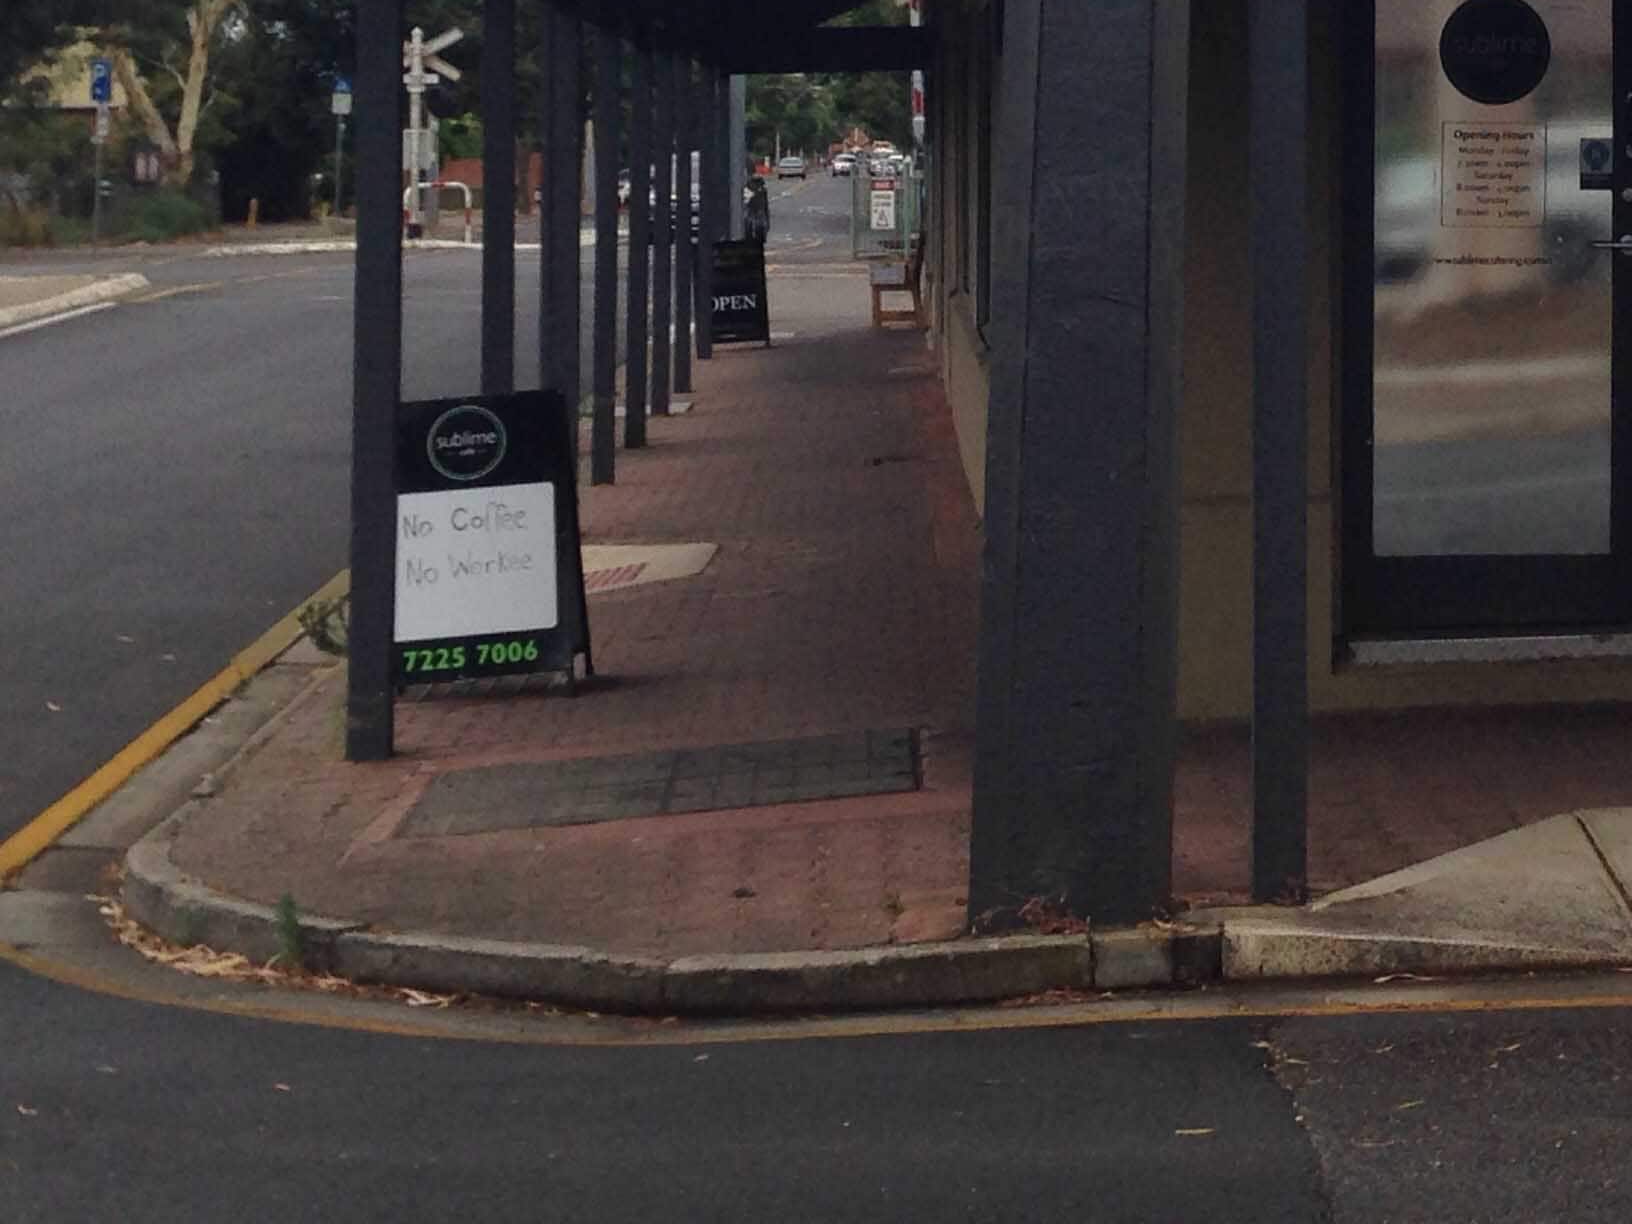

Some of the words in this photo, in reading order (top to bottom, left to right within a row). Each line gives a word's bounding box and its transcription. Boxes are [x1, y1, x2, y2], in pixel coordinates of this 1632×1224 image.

[1453, 129, 1500, 143] Opening
[402, 514, 433, 539] No
[450, 502, 528, 533] Coffee
[405, 558, 439, 588] No
[403, 646, 465, 672] 7225
[476, 640, 538, 664] 7006
